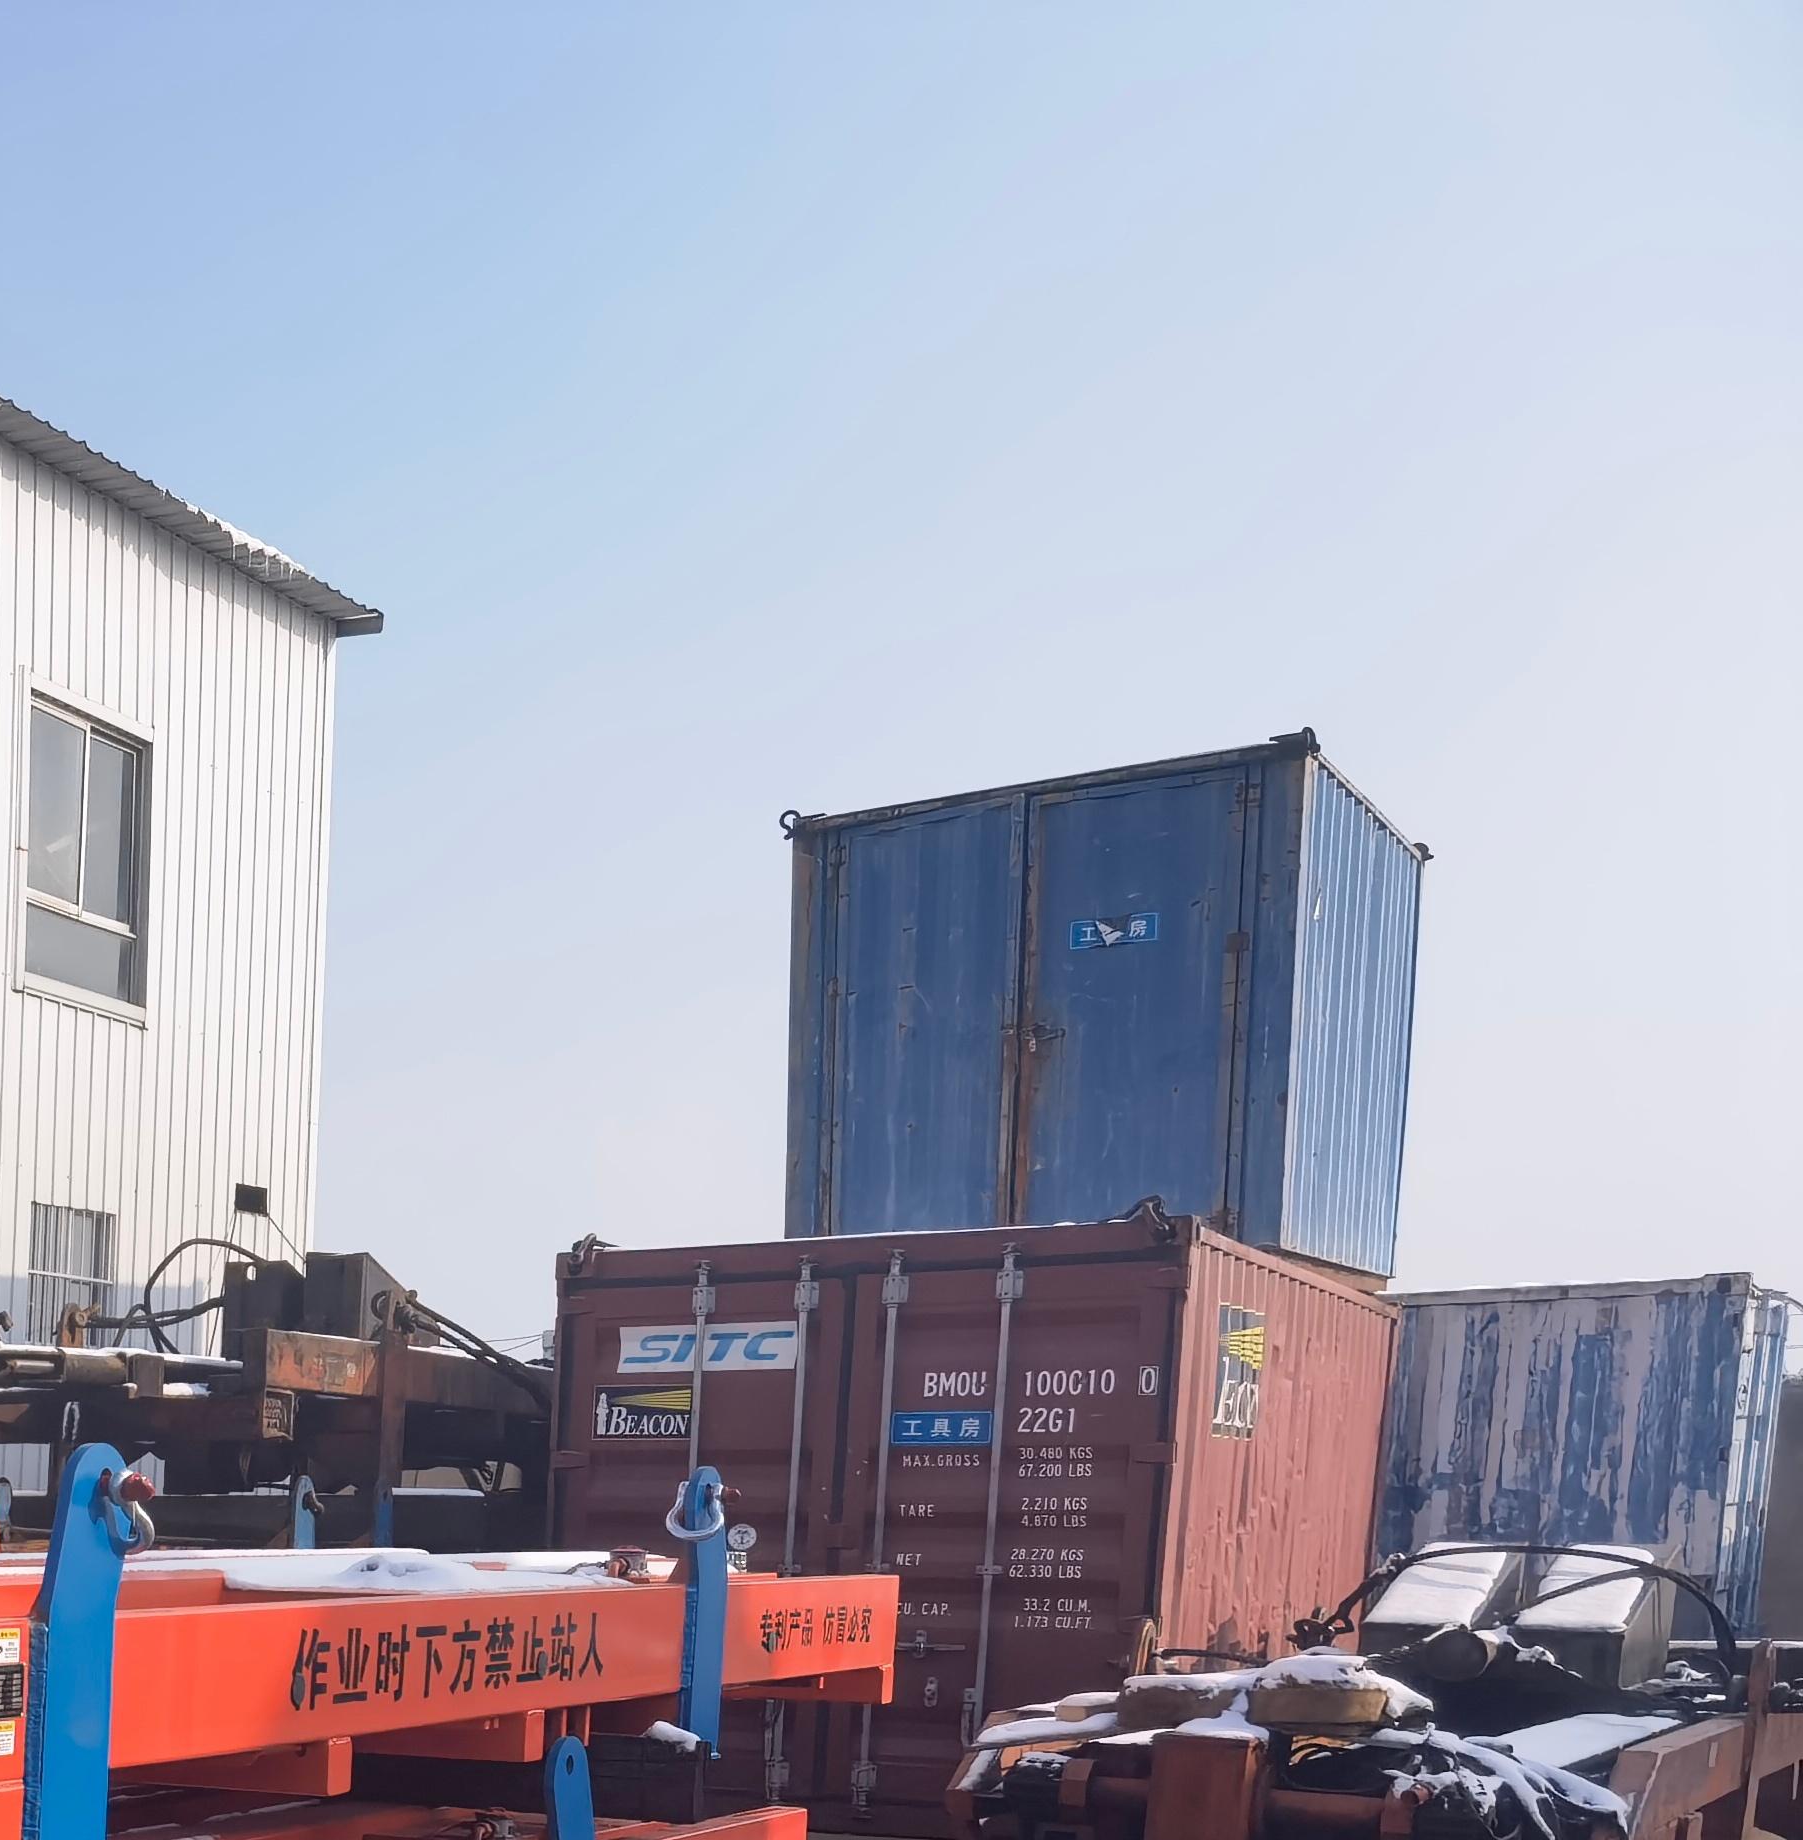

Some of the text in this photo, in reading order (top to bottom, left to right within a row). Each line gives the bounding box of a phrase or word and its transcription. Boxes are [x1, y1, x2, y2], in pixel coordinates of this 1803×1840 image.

[1079, 919, 1147, 941] 工房
[623, 1330, 795, 1364] SITC
[923, 1371, 988, 1398] BMOU
[607, 1406, 689, 1436] BEACON
[901, 1417, 981, 1438] 工具房
[1017, 1407, 1075, 1433] 22G1
[1069, 1446, 1094, 1459] KGS
[1068, 1463, 1093, 1477] LBS
[899, 1504, 935, 1518] TARE
[1064, 1497, 1088, 1511] KGS
[1064, 1514, 1088, 1528] LBS
[896, 1553, 922, 1566] NET
[1060, 1549, 1085, 1561] KGS
[1058, 1565, 1082, 1579] LBS
[759, 1604, 873, 1654] 专利产品 仿冒必究
[289, 1611, 604, 1711] 作业时下方禁止站人
